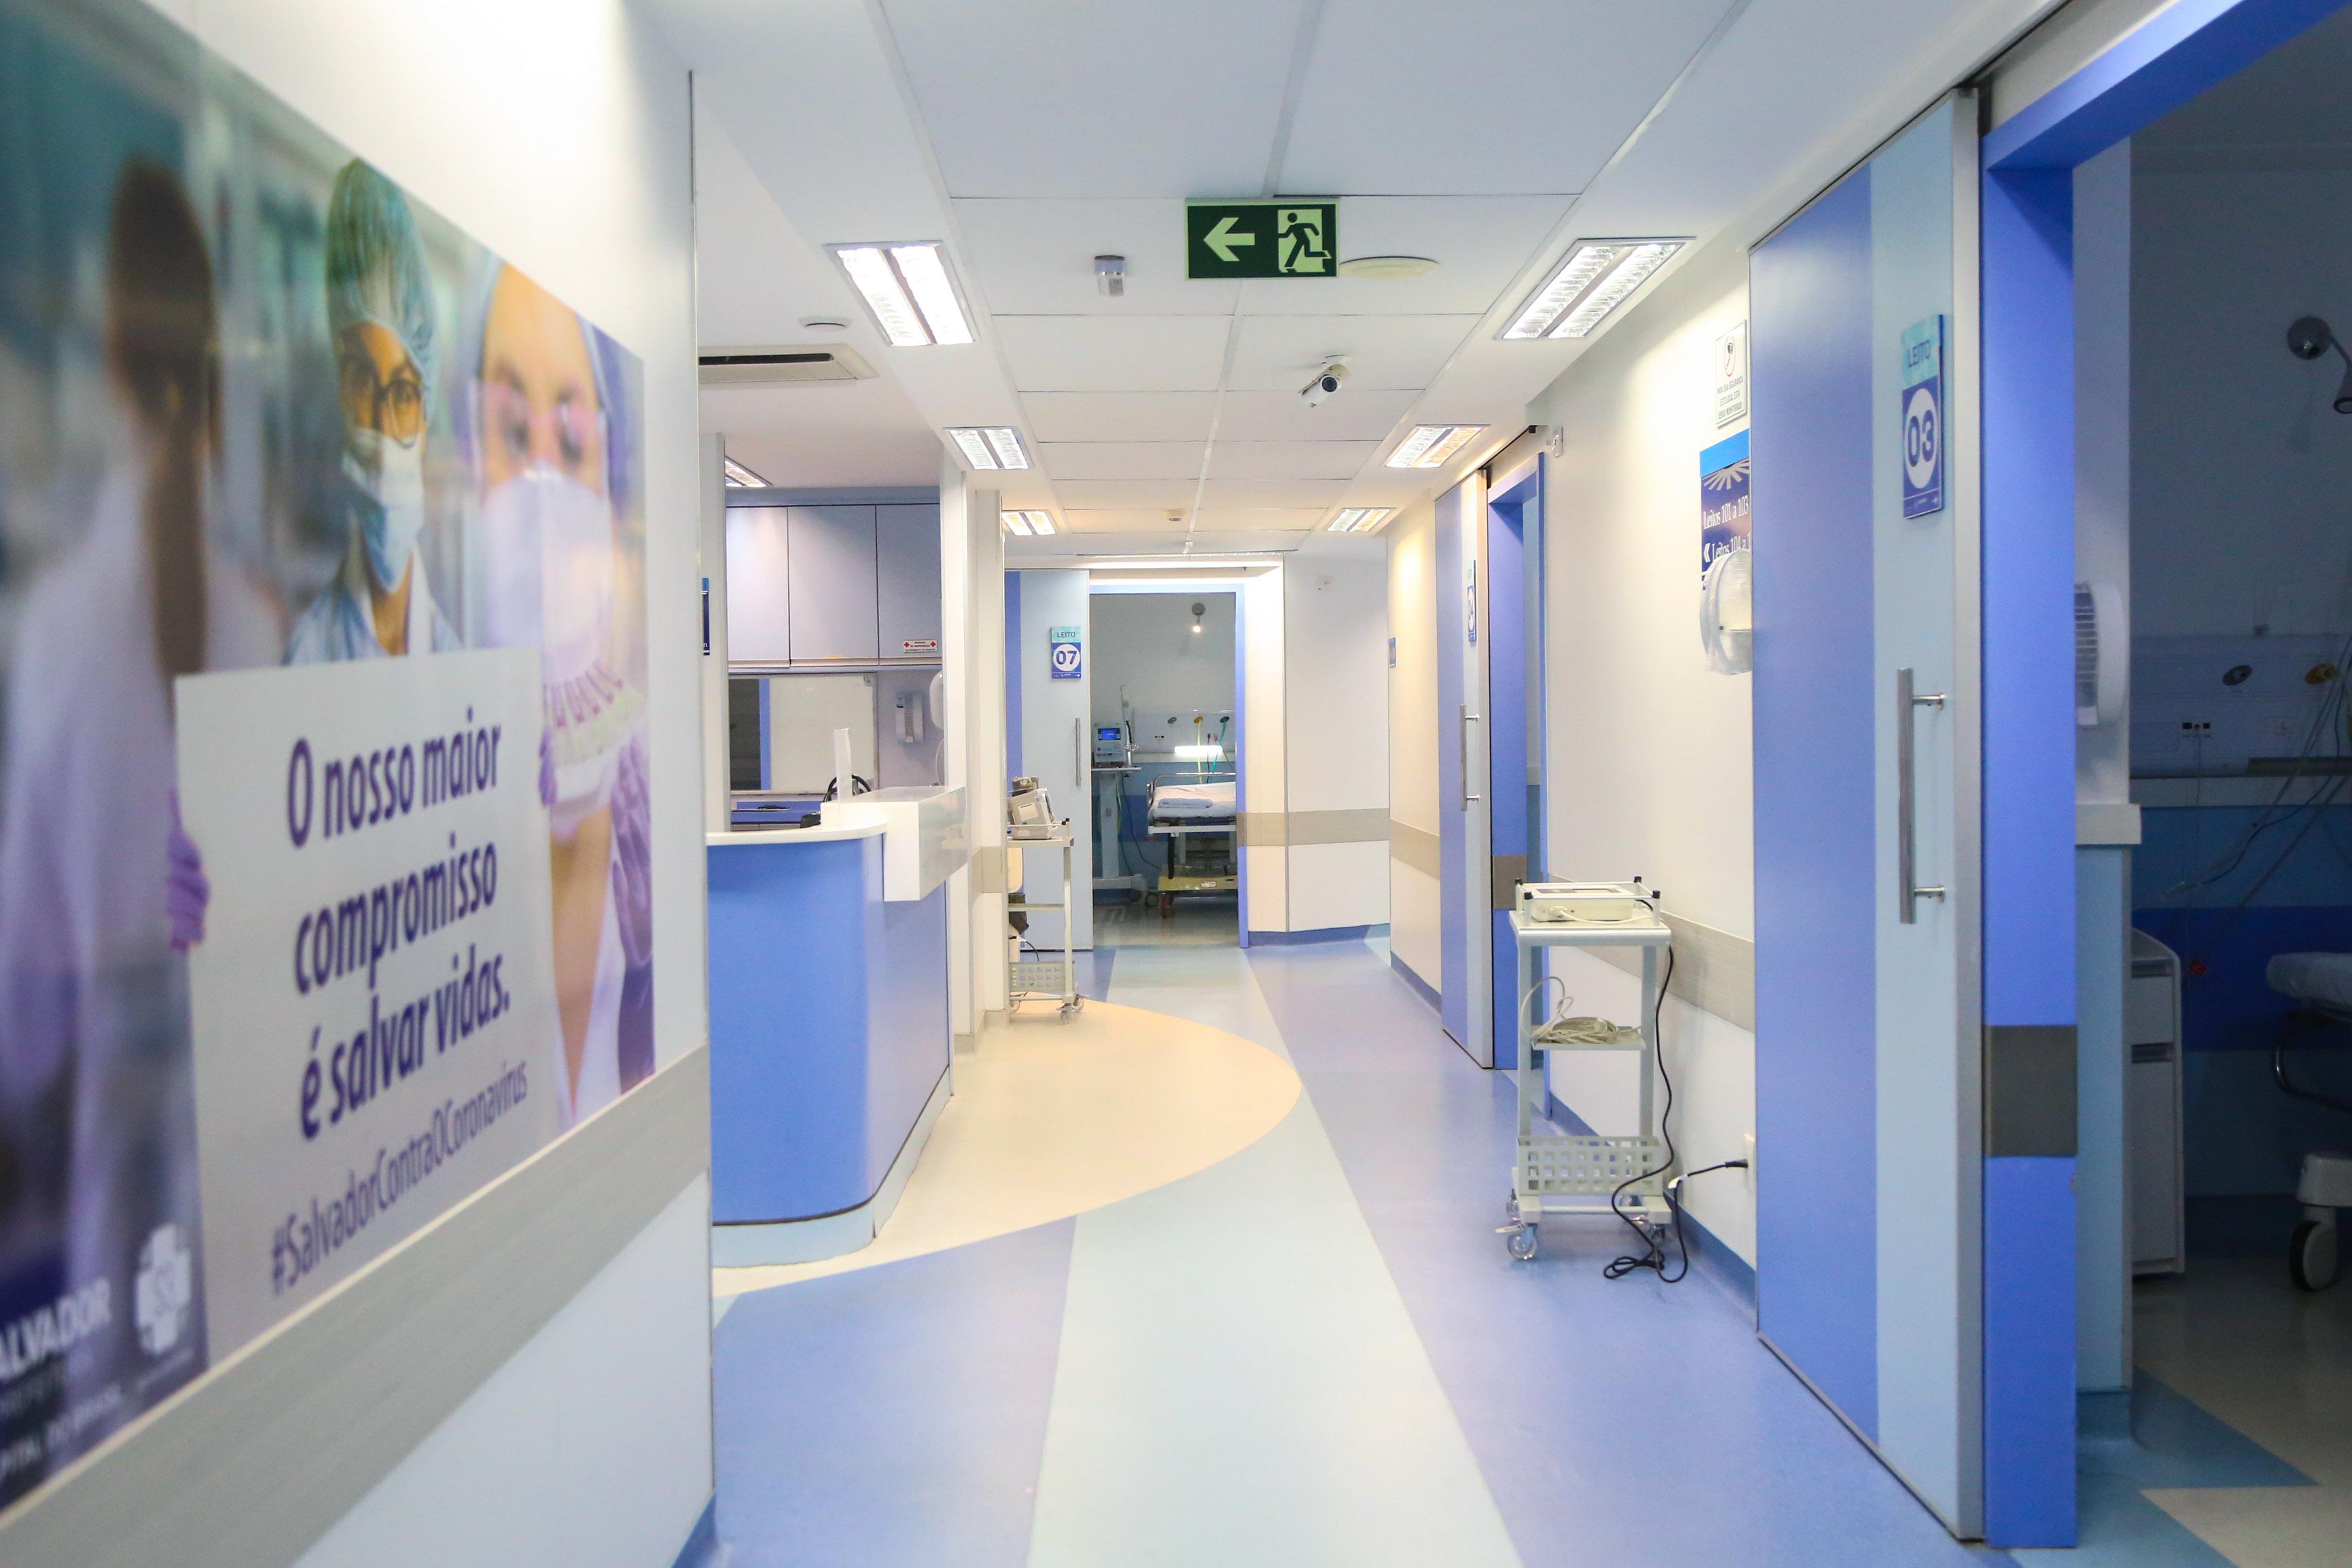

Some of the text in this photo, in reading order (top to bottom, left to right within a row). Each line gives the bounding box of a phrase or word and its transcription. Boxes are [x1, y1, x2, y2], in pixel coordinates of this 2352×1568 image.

[1907, 339, 1931, 370] LEITO
[1907, 409, 1935, 468] 03
[1703, 510, 1721, 529] Leitos
[1056, 650, 1077, 665] 07
[287, 705, 501, 850] O nosso maior
[293, 830, 497, 995] compromisso
[300, 942, 510, 1141] é salvar vidas.
